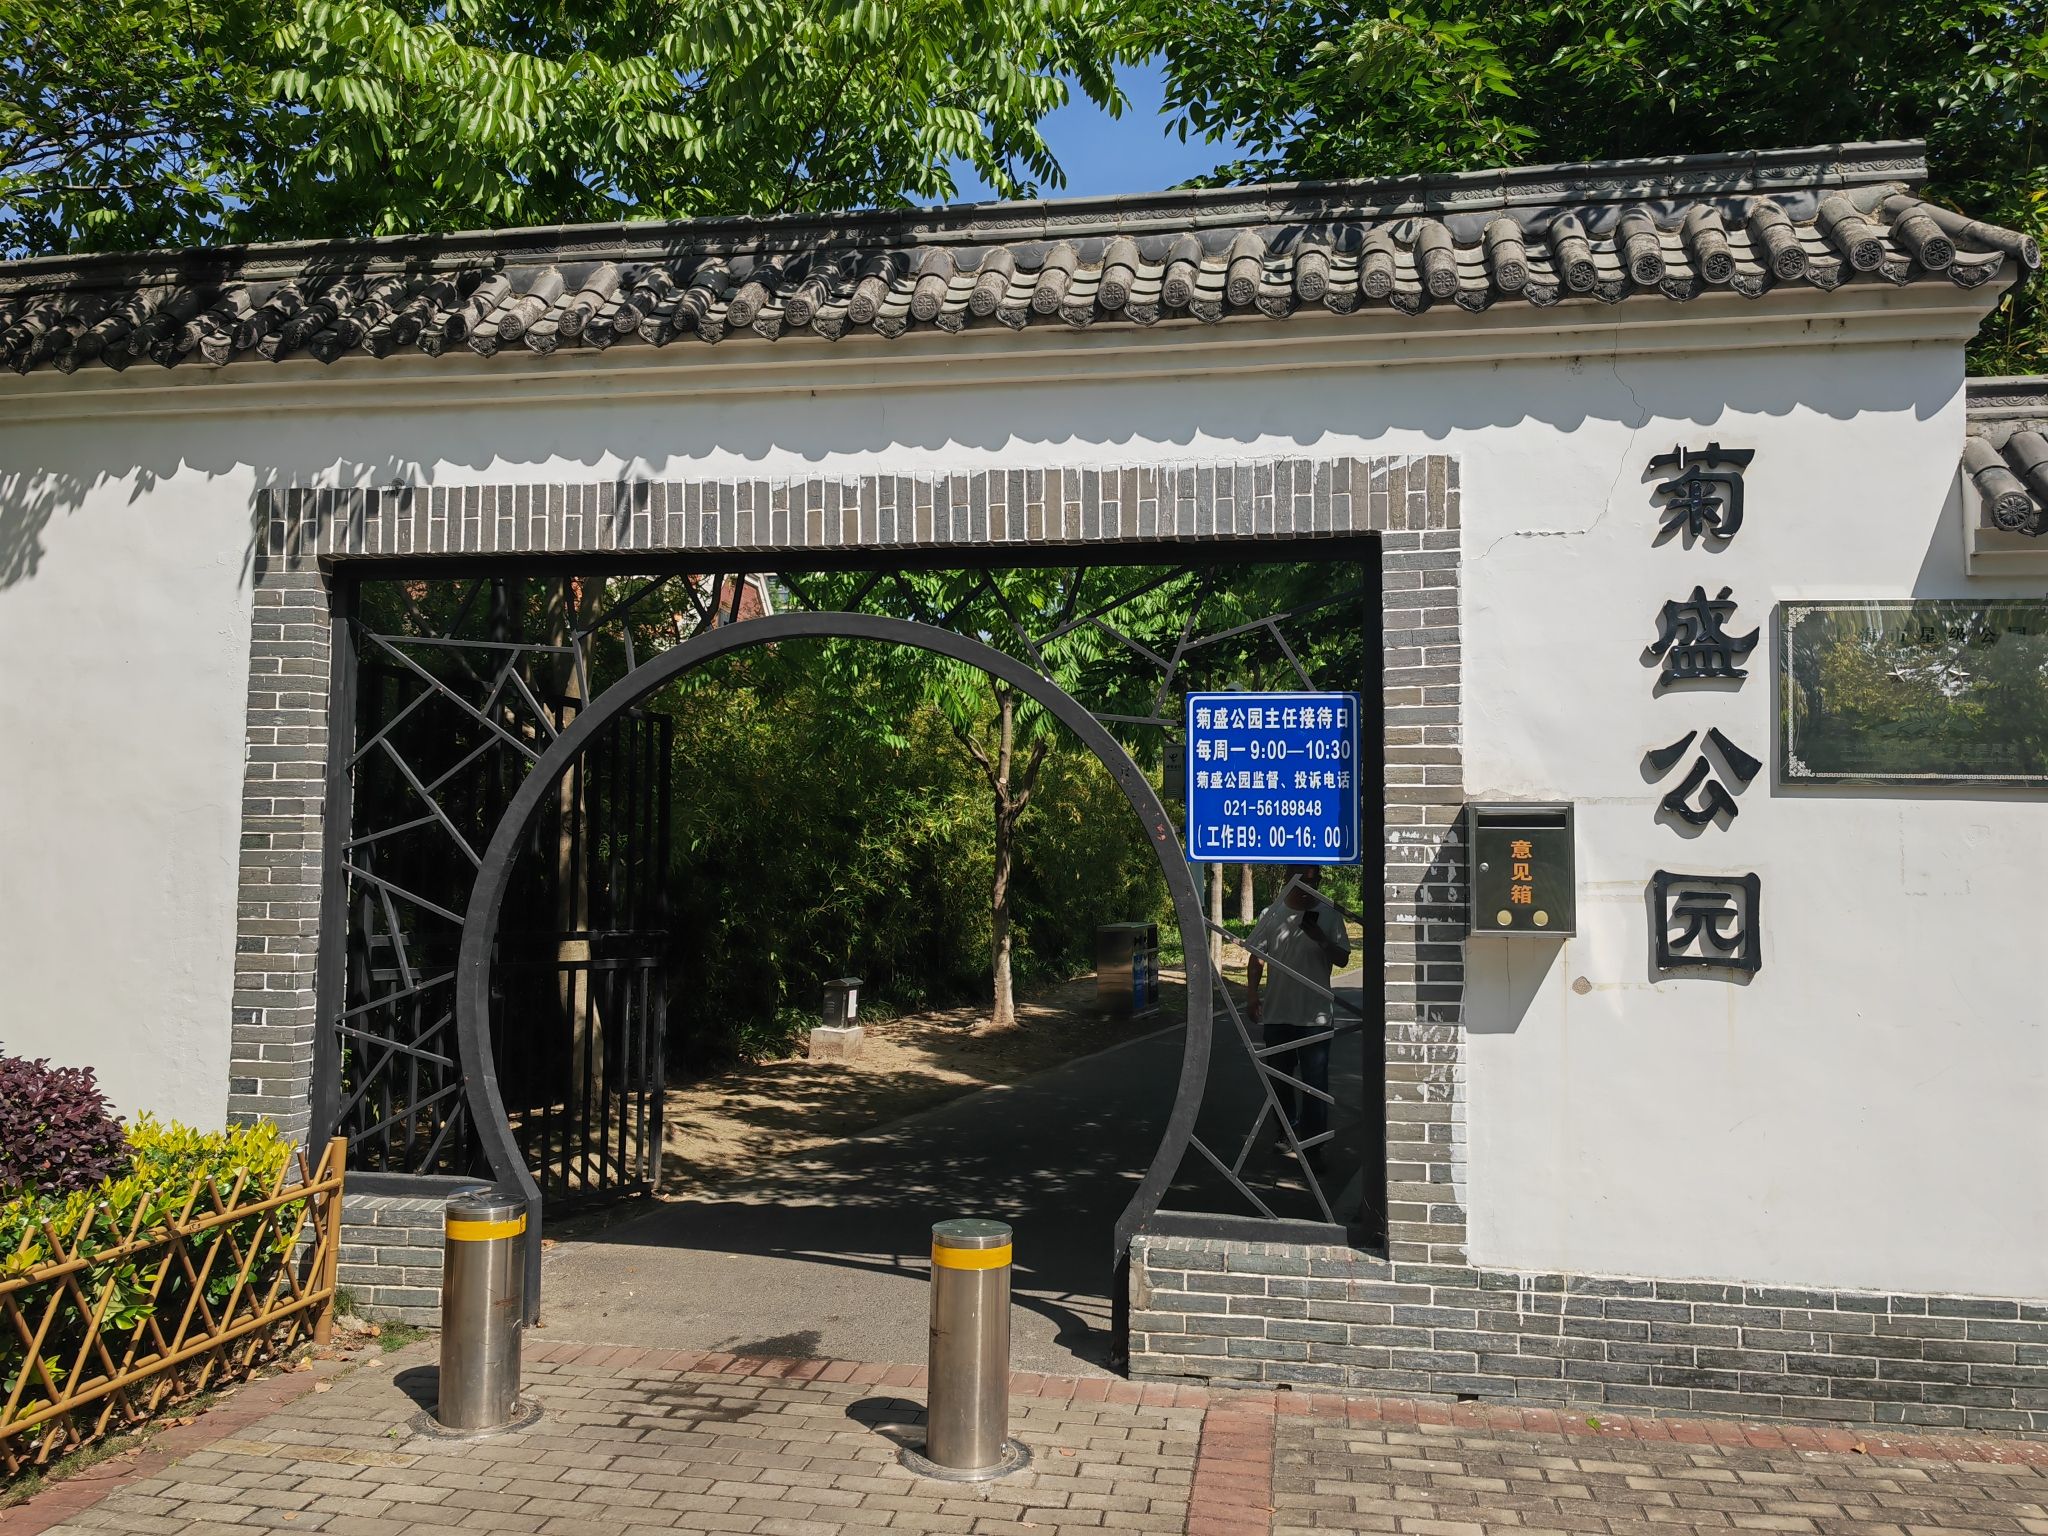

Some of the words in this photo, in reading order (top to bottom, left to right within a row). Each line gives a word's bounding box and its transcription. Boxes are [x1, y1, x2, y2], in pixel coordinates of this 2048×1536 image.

[1196, 707, 1349, 730] 菊盛公园主任接待日
[1647, 441, 1763, 973] 菊盛公园
[1196, 771, 1351, 790] 菊盛公园监督、投诉电话
[1223, 799, 1322, 817] 021-56189848
[1510, 839, 1533, 904] 意见箱
